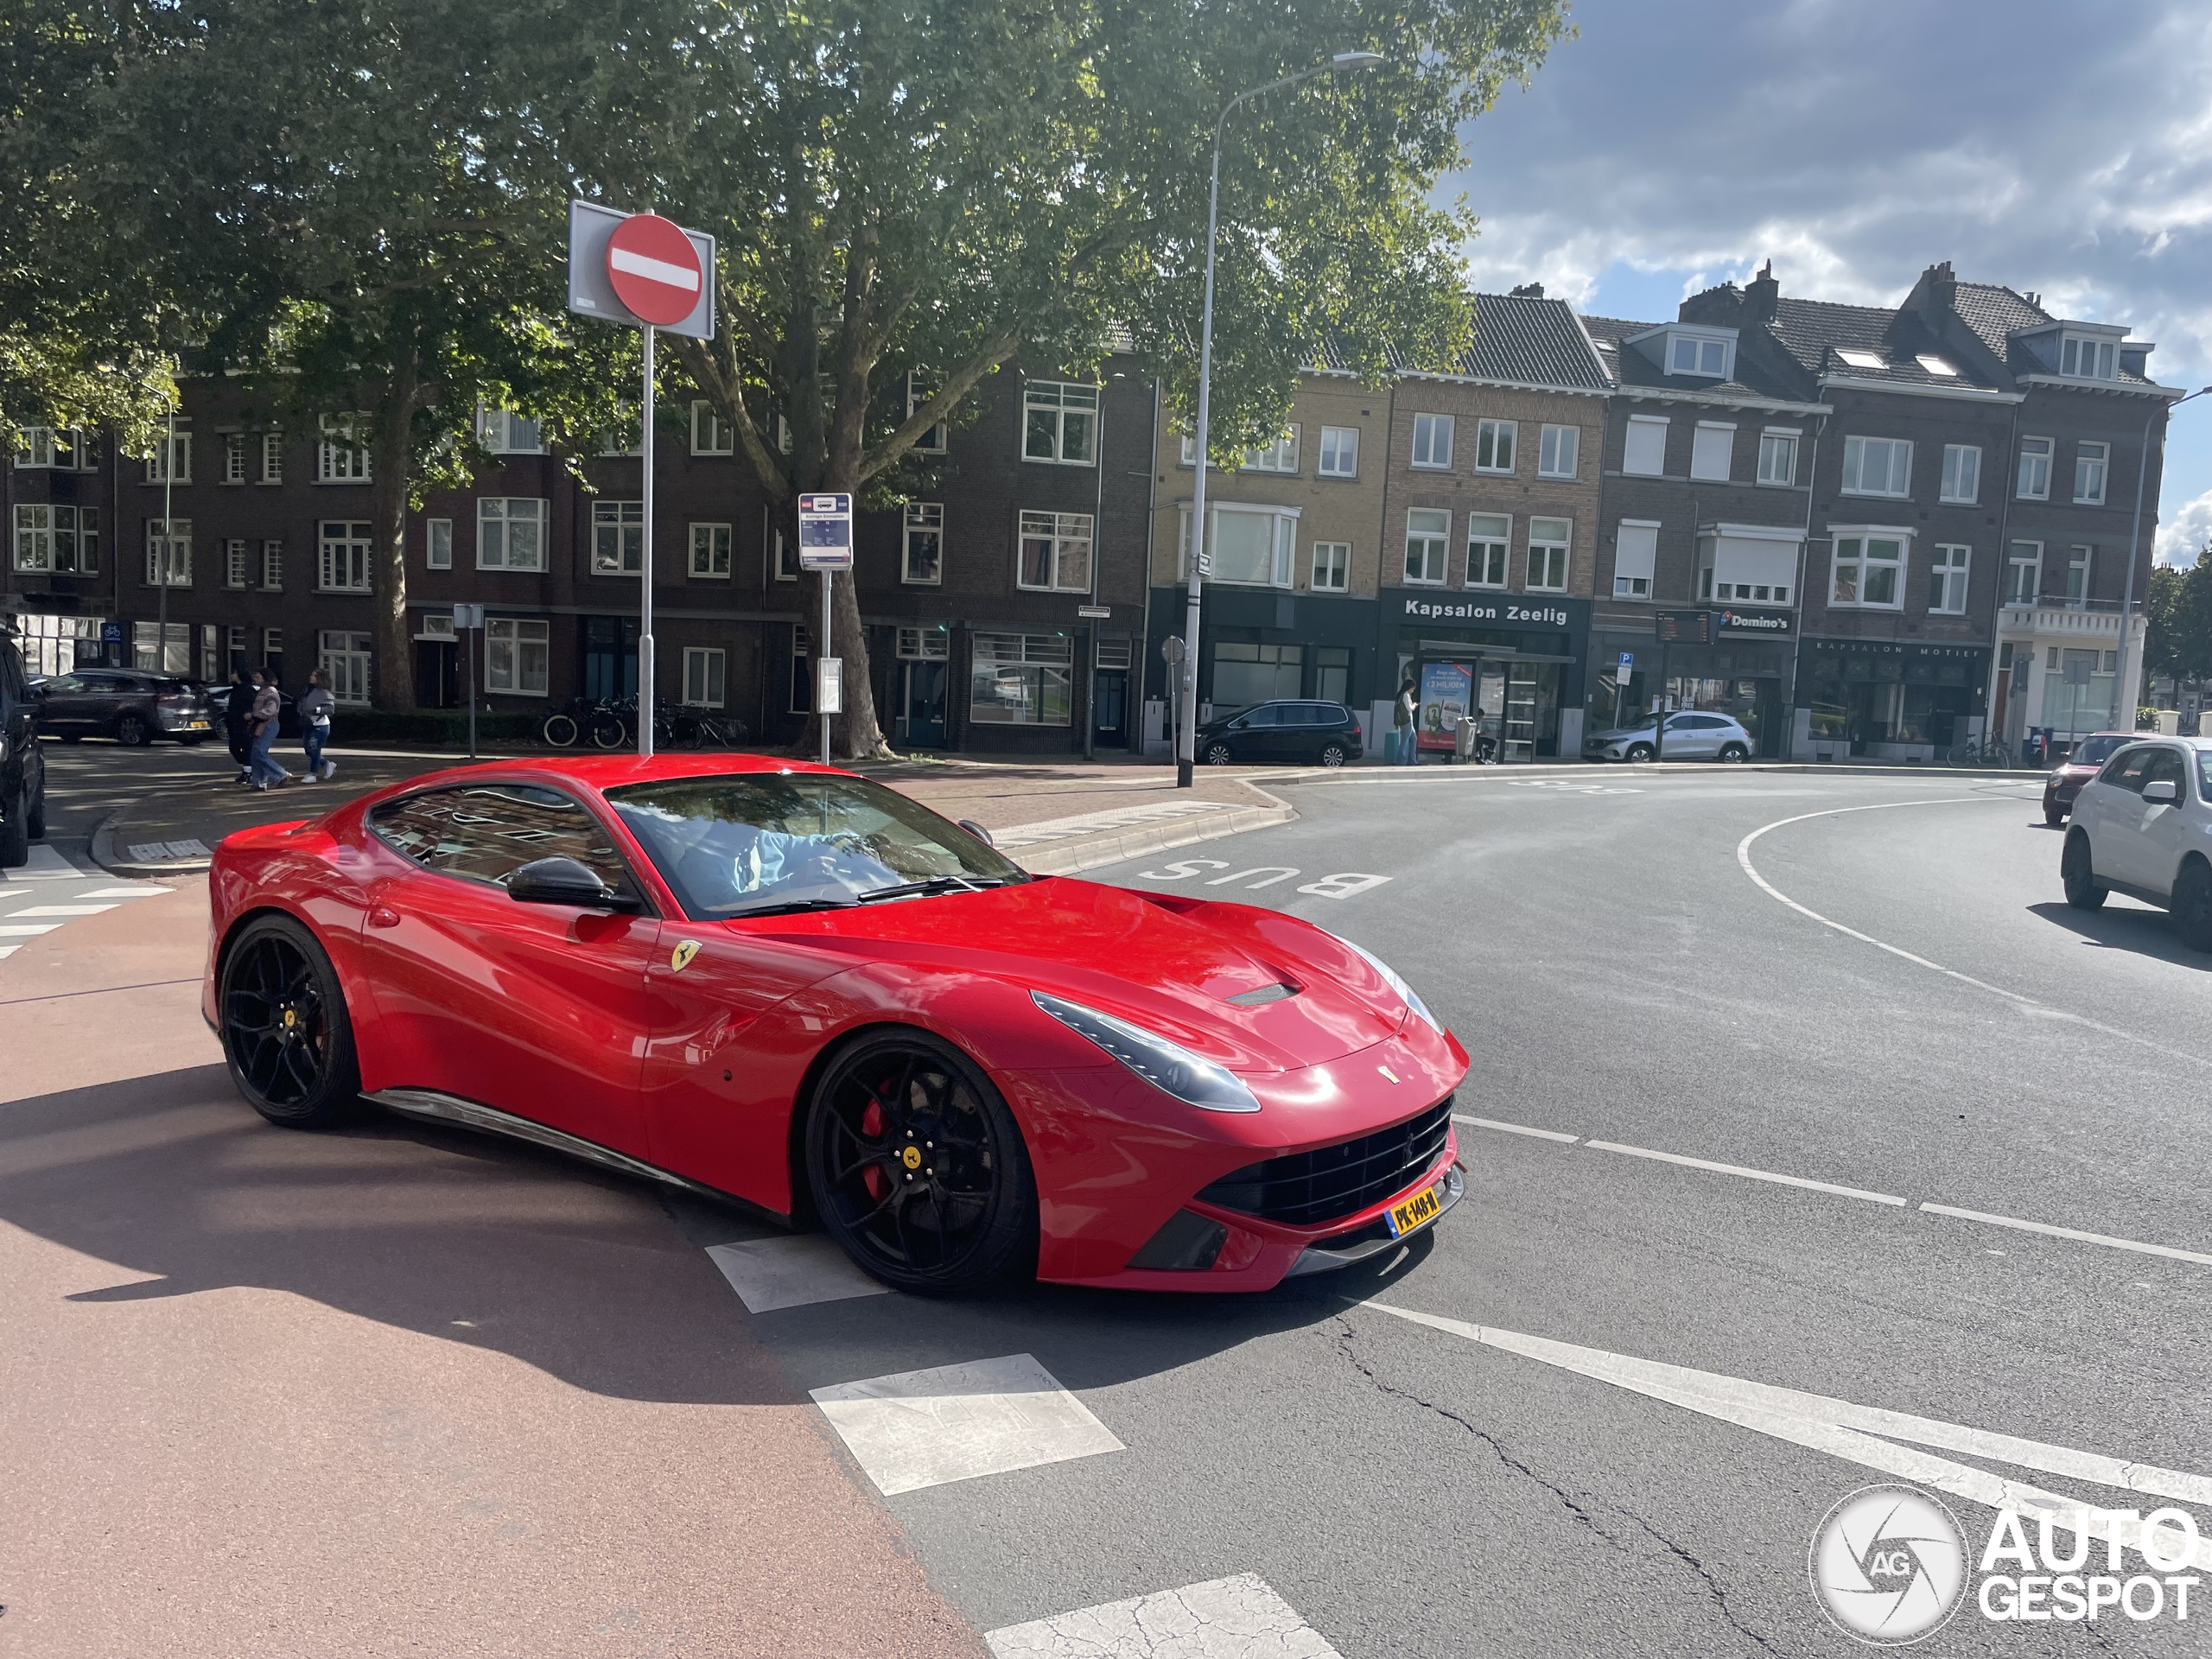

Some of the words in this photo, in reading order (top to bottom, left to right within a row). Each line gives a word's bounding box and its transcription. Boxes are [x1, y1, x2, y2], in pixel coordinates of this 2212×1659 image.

[1405, 600, 1496, 619] Kapsalon
[1506, 606, 1567, 626] Zeelig
[1732, 615, 1788, 629] Domino's
[1816, 642, 1902, 653] KAPSALON
[1920, 648, 1979, 658] MOTIEF
[1137, 859, 1394, 900] BUS
